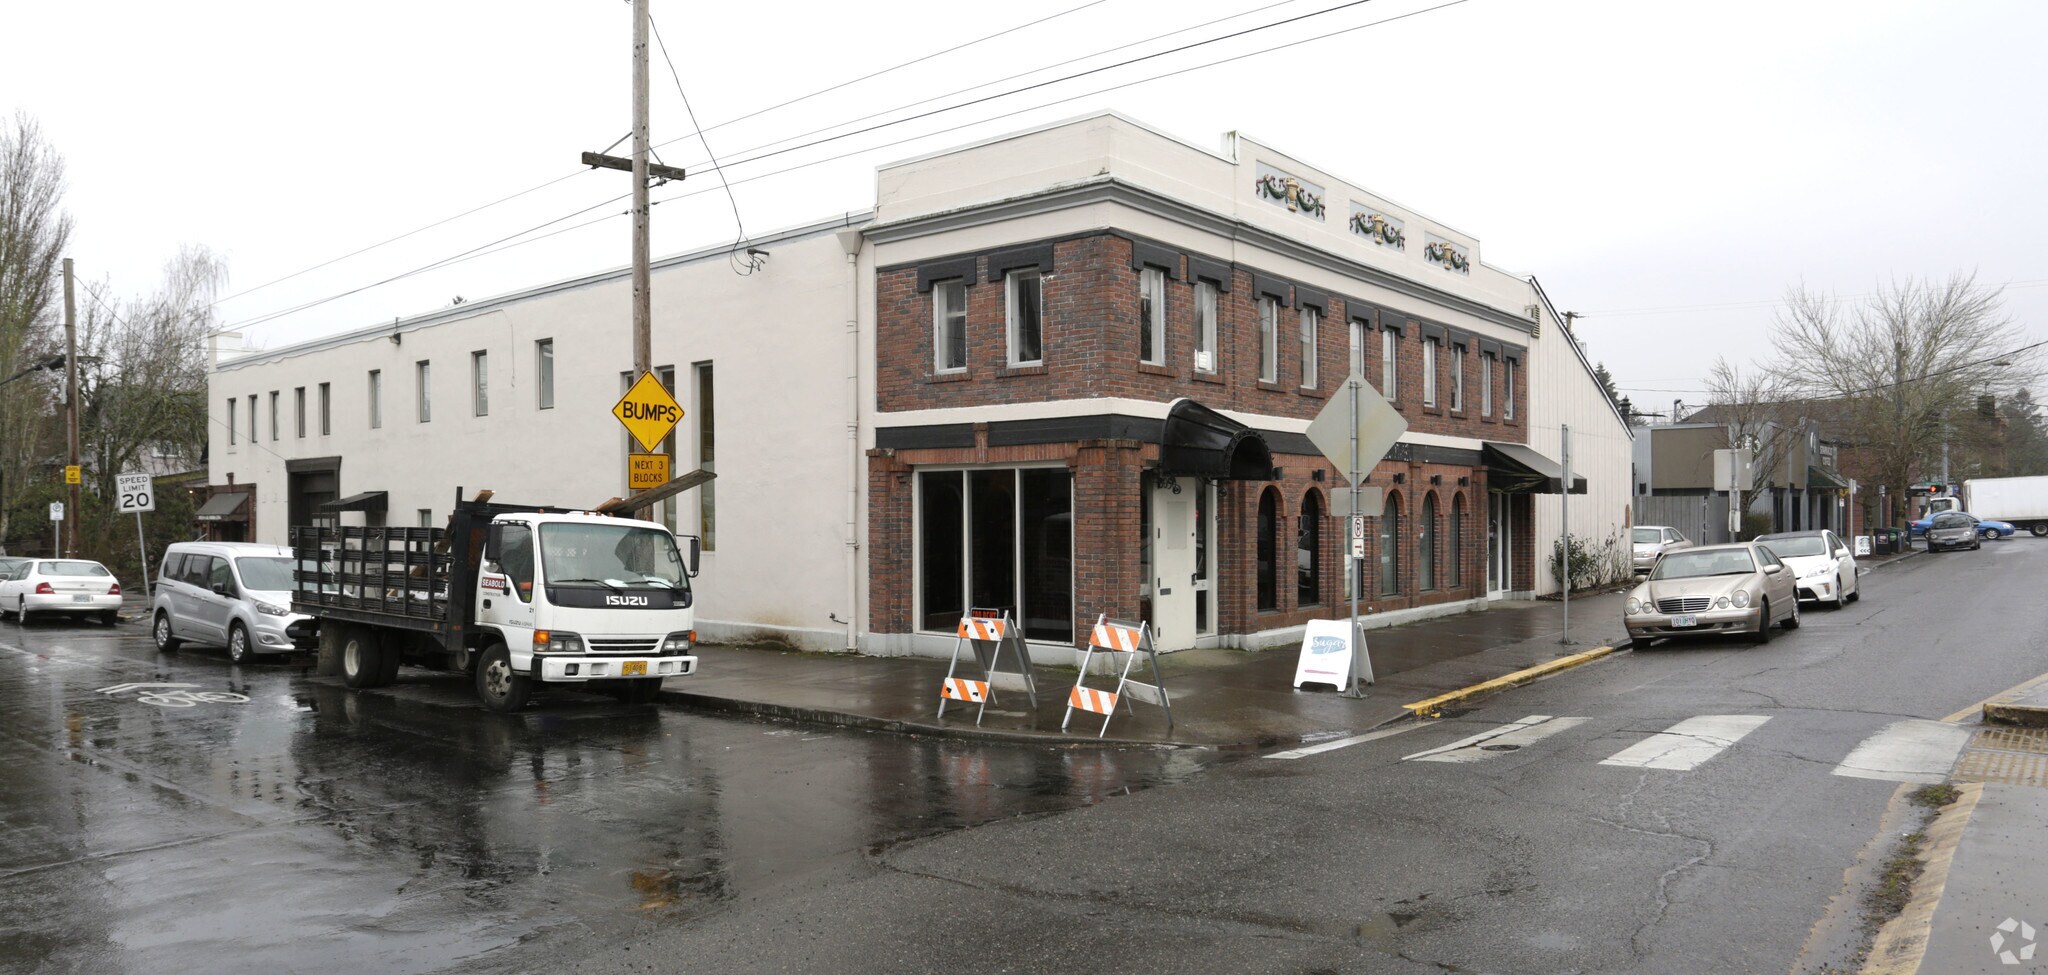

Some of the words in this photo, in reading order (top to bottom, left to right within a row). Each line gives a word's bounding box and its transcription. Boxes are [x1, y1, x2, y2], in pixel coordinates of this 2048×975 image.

[623, 401, 677, 424] BUMPS
[635, 460, 653, 470] NEXT
[658, 461, 664, 470] 3
[119, 476, 148, 485] SPEED
[634, 473, 663, 483] BLOCKS
[123, 484, 146, 493] LIMIT
[122, 492, 149, 508] 20
[482, 578, 506, 588] SEABOLD
[605, 595, 648, 606] ISUZU
